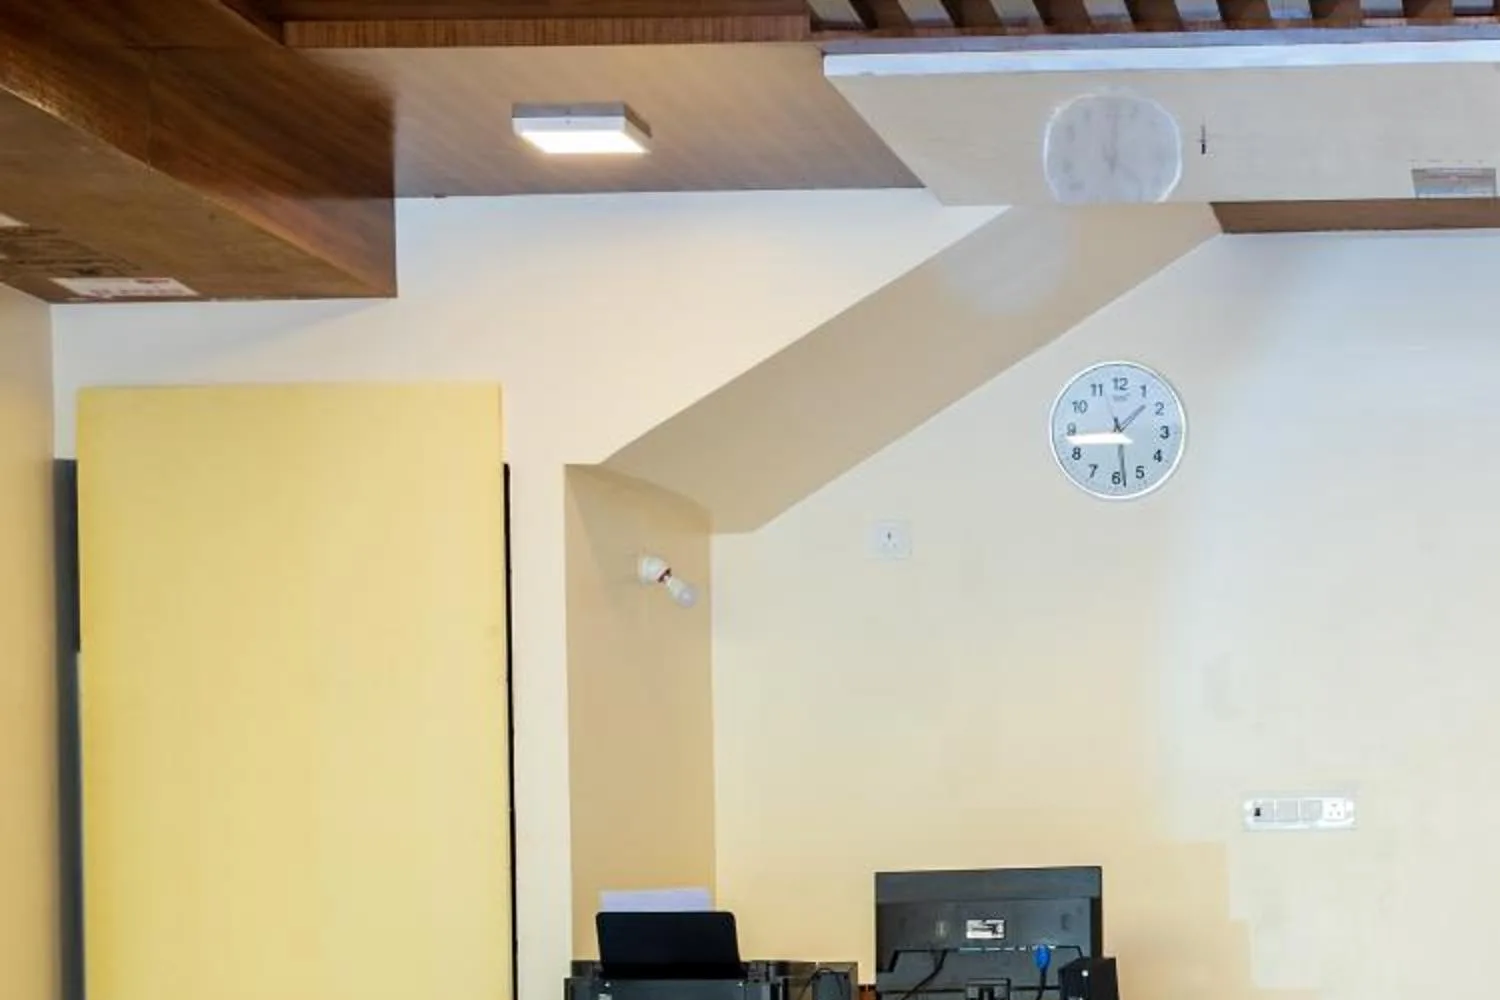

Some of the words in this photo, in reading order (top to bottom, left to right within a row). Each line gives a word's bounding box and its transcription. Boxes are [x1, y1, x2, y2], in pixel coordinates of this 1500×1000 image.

[1091, 384, 1103, 397] 11
[1112, 377, 1128, 391] 12
[1140, 385, 1147, 397] 1
[1072, 400, 1088, 414] 10
[1154, 402, 1164, 415] 2
[1066, 423, 1077, 436] 9
[1160, 426, 1170, 439] 3
[1072, 447, 1081, 460] 8
[1153, 449, 1162, 462] 4
[1088, 464, 1098, 478] 7
[1135, 466, 1145, 479] 5
[1111, 472, 1121, 485] 6
